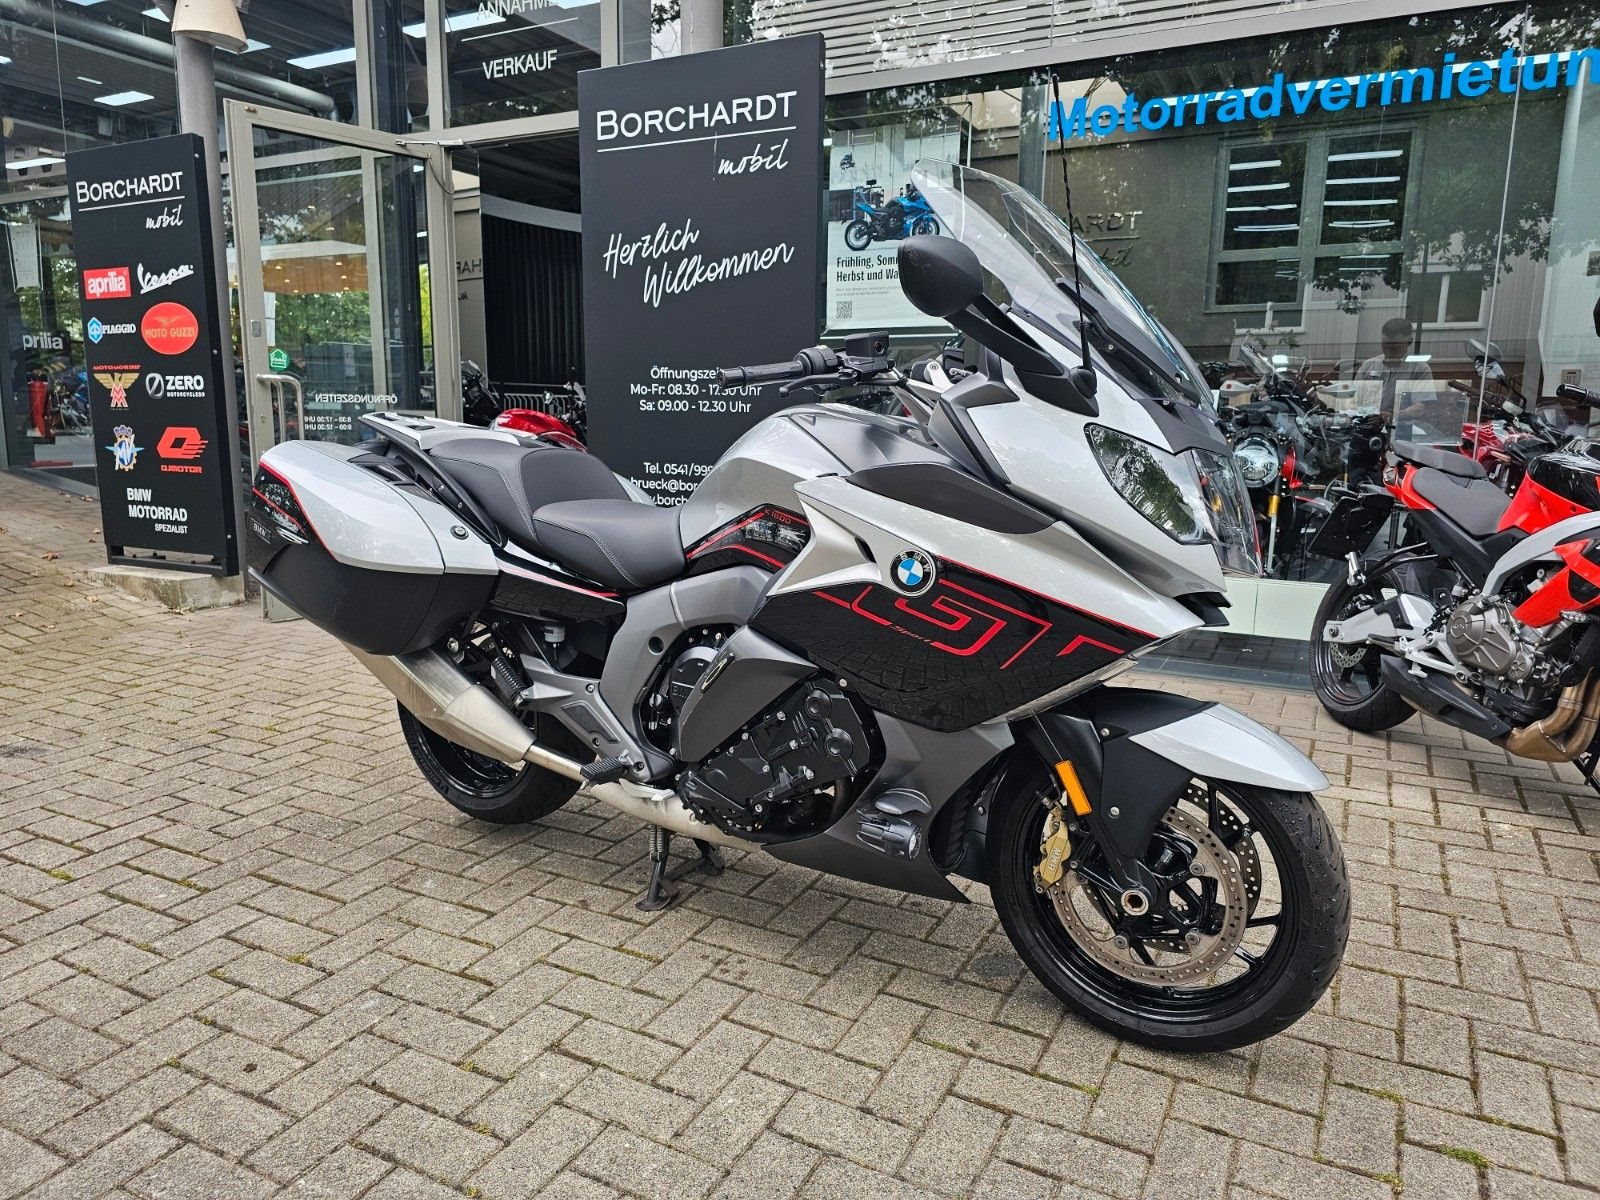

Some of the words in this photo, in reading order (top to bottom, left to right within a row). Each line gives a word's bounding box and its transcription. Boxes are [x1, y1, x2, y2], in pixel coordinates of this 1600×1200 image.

[482, 49, 558, 80] VERKAUF
[596, 90, 798, 142] BORCHARDT
[717, 138, 790, 176] mobil
[76, 171, 184, 204] BORCHARDT
[145, 204, 184, 230] mobil
[602, 218, 701, 280] Herzlich
[836, 255, 875, 270] Frühling,
[137, 263, 194, 295] Vespa
[643, 242, 795, 308] Willkommen
[836, 270, 866, 282] Herbst
[867, 269, 883, 281] und
[87, 271, 128, 297] aprilia
[104, 323, 137, 335] PIAGGIO
[165, 375, 205, 391] ZERO
[630, 383, 666, 396] Mo-Fr:
[667, 383, 699, 396] 08.30
[639, 400, 656, 412] Sa:
[657, 400, 689, 412] 09.00
[698, 401, 727, 413] 12.30
[729, 401, 752, 413] Uhr
[160, 464, 203, 474] QJMOTOR
[643, 462, 662, 475] Tel.
[126, 487, 152, 502] BMW
[128, 504, 188, 522] MOTORRAD
[154, 523, 188, 534] SPEZIALIST
